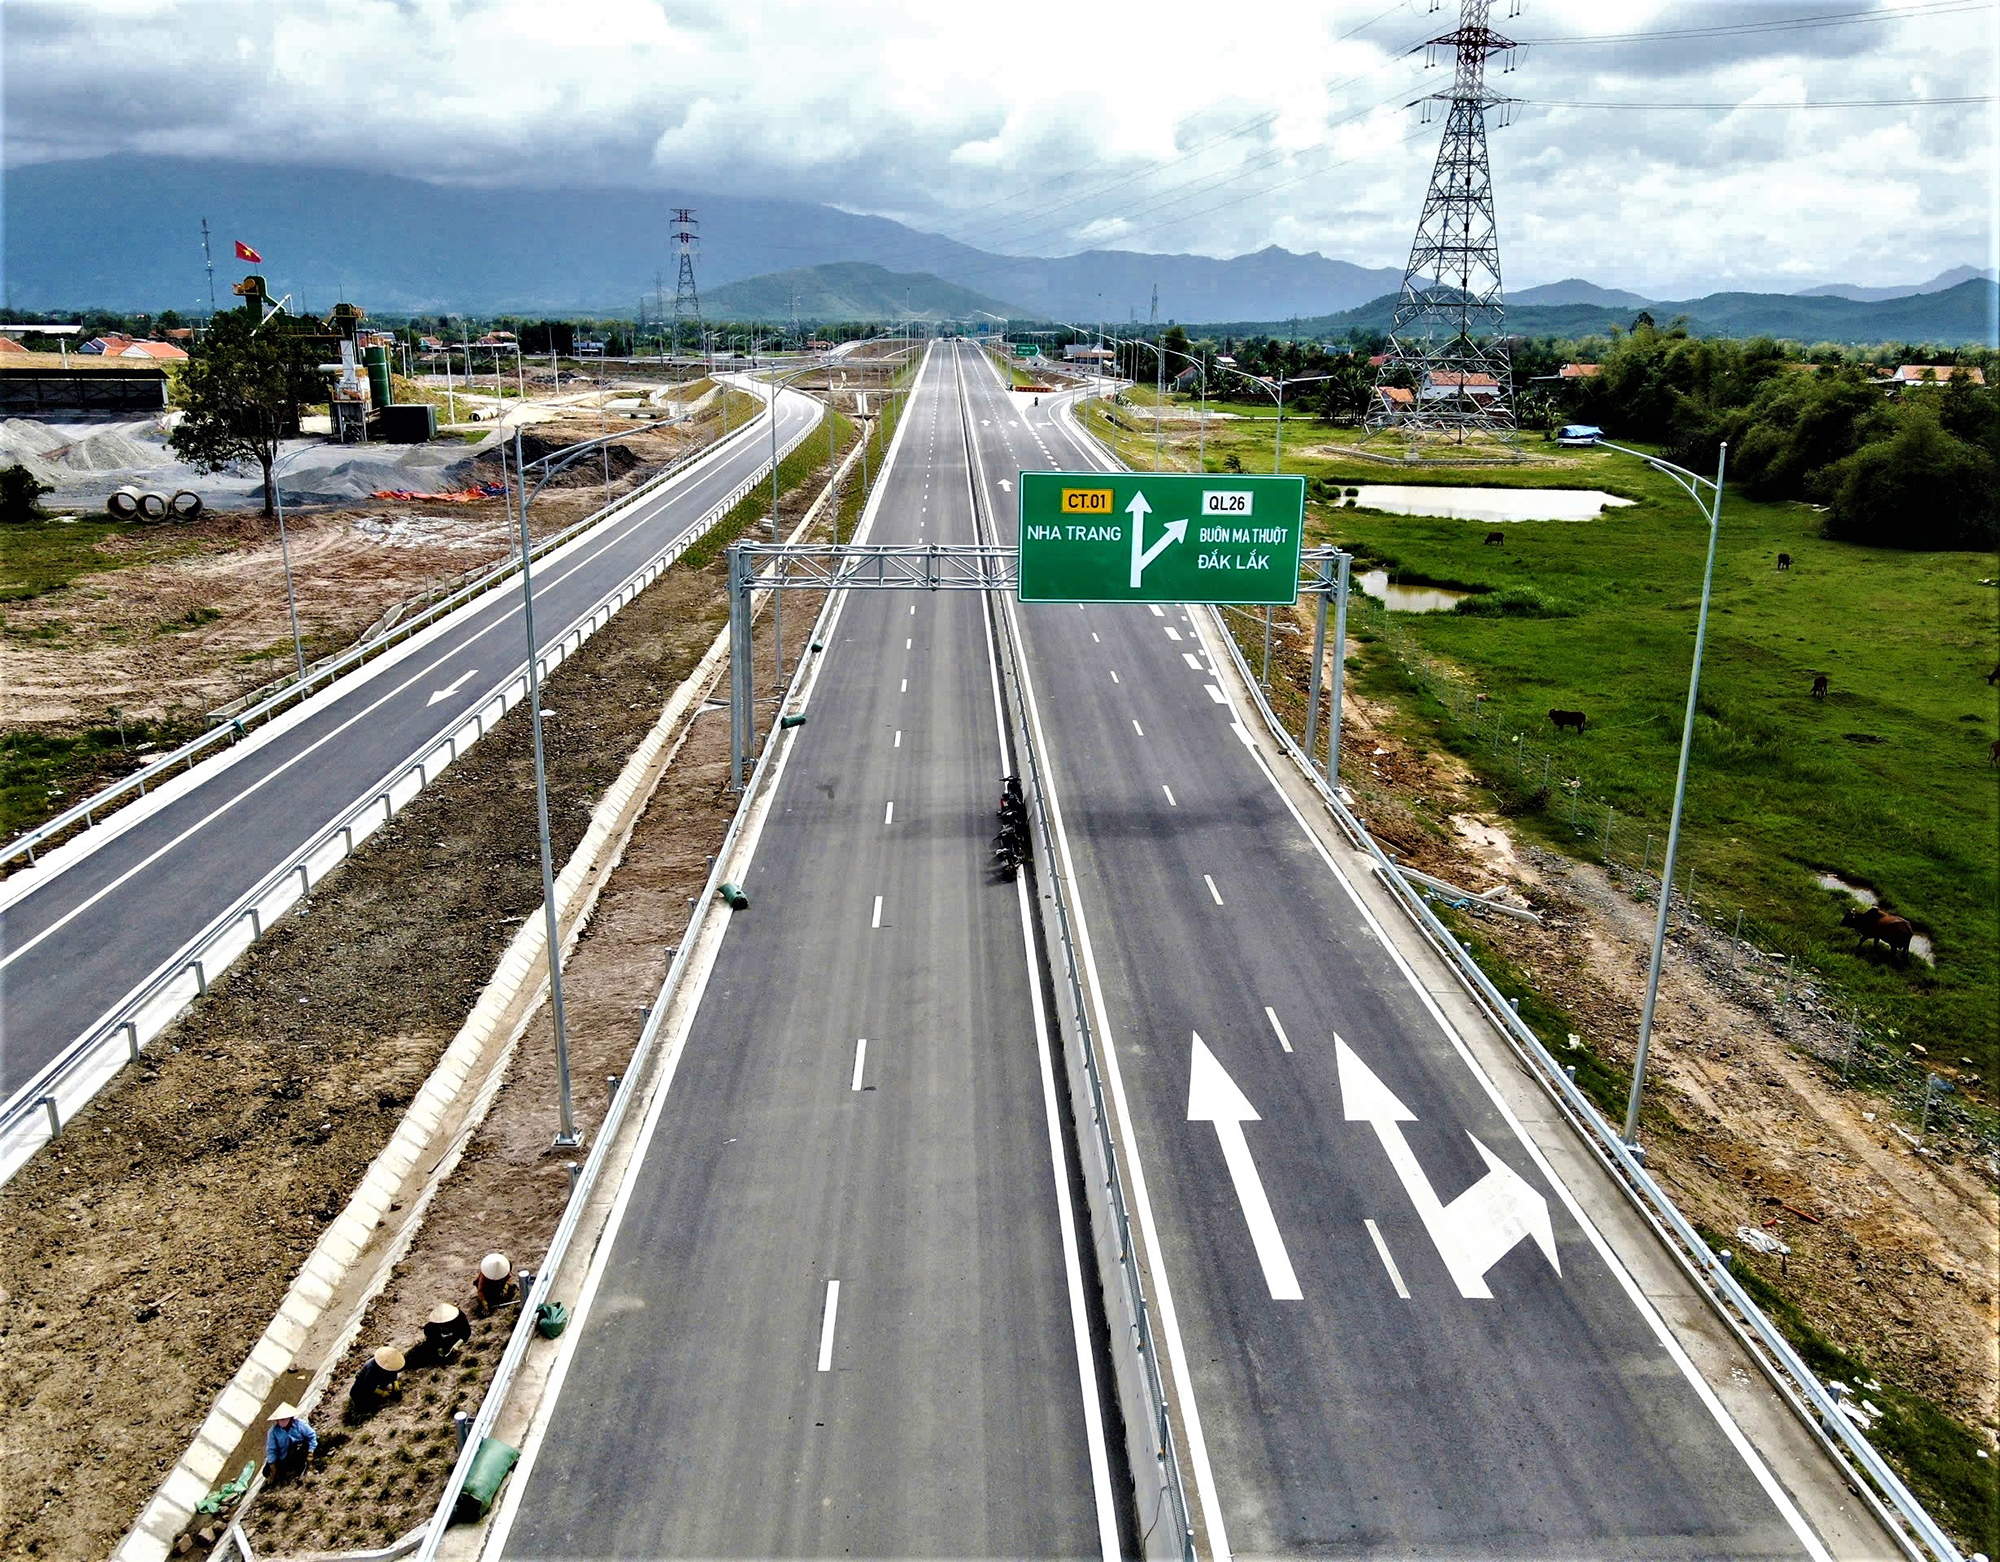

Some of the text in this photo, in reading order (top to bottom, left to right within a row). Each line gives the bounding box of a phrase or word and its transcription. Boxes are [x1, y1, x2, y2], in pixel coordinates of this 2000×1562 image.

[1068, 494, 1106, 509] CT.01
[1209, 495, 1245, 511] QL26
[1027, 525, 1122, 541] NHA TRANG
[1199, 525, 1288, 546] BUÔN MA THUỘT
[1197, 548, 1270, 570] ĐẮK LẮK
